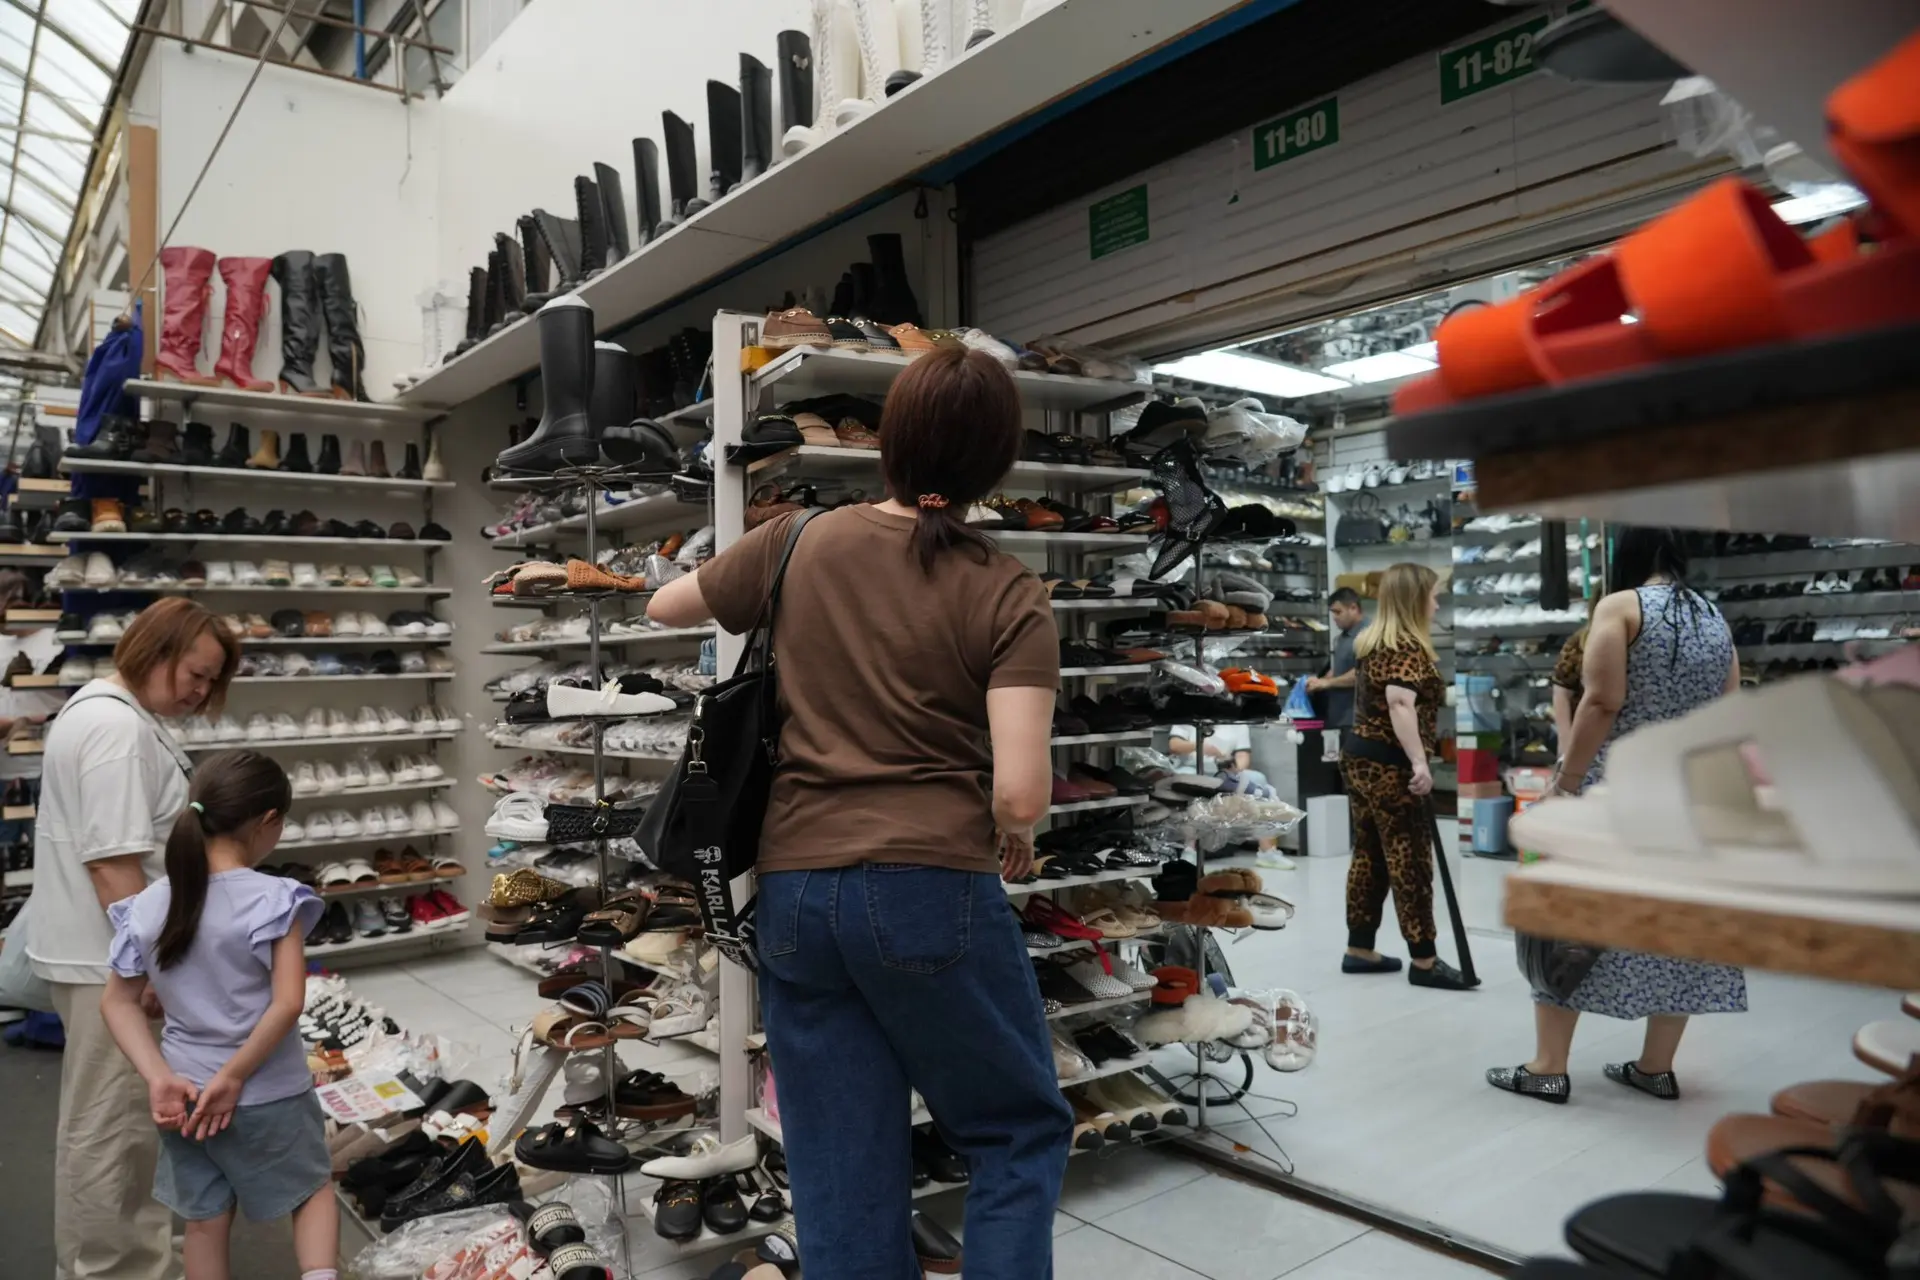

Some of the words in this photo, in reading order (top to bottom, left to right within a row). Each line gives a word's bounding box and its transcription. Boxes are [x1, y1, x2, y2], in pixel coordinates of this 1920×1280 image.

[1453, 33, 1532, 90] 11-82
[1263, 112, 1327, 160] 11-80
[701, 868, 725, 915] KARL
